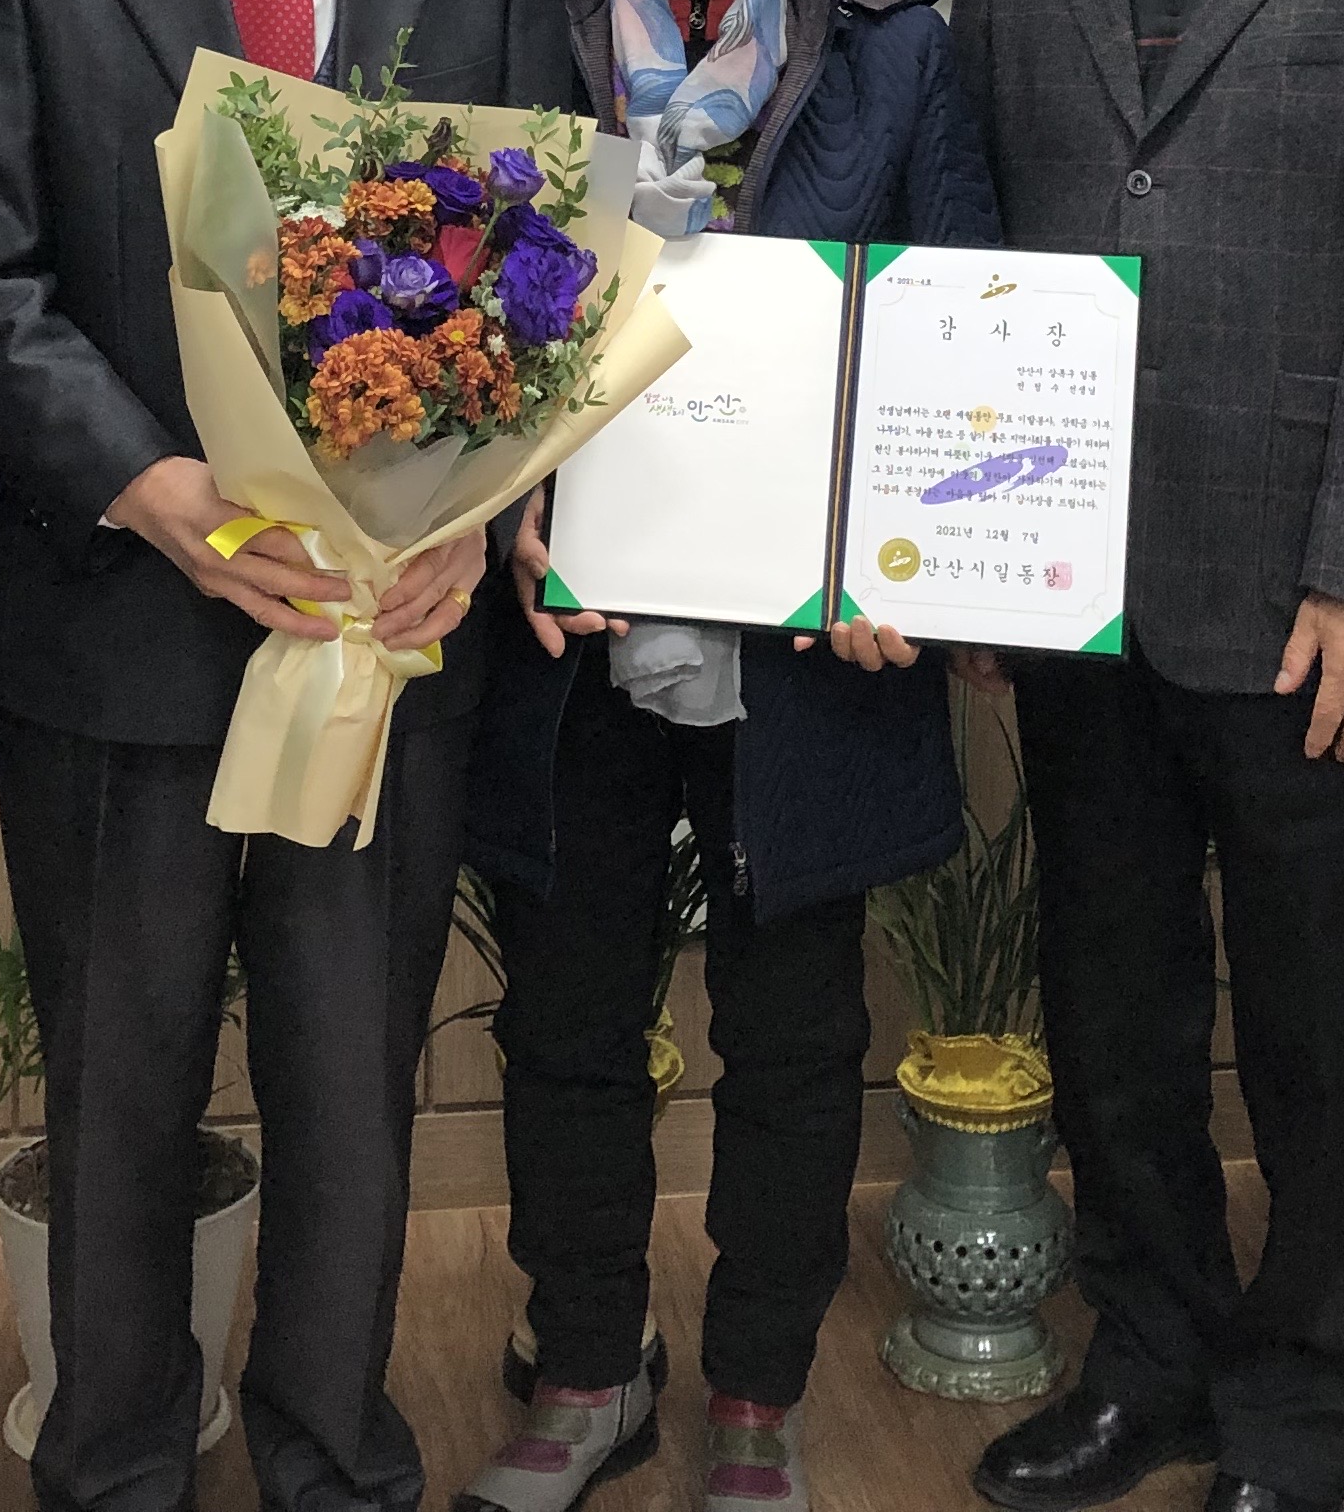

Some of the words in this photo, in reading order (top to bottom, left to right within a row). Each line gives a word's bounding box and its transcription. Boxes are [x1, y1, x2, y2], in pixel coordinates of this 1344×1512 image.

[936, 525, 973, 538] 2021년
[985, 529, 1009, 542] 12월
[1022, 532, 1039, 544] 7일
